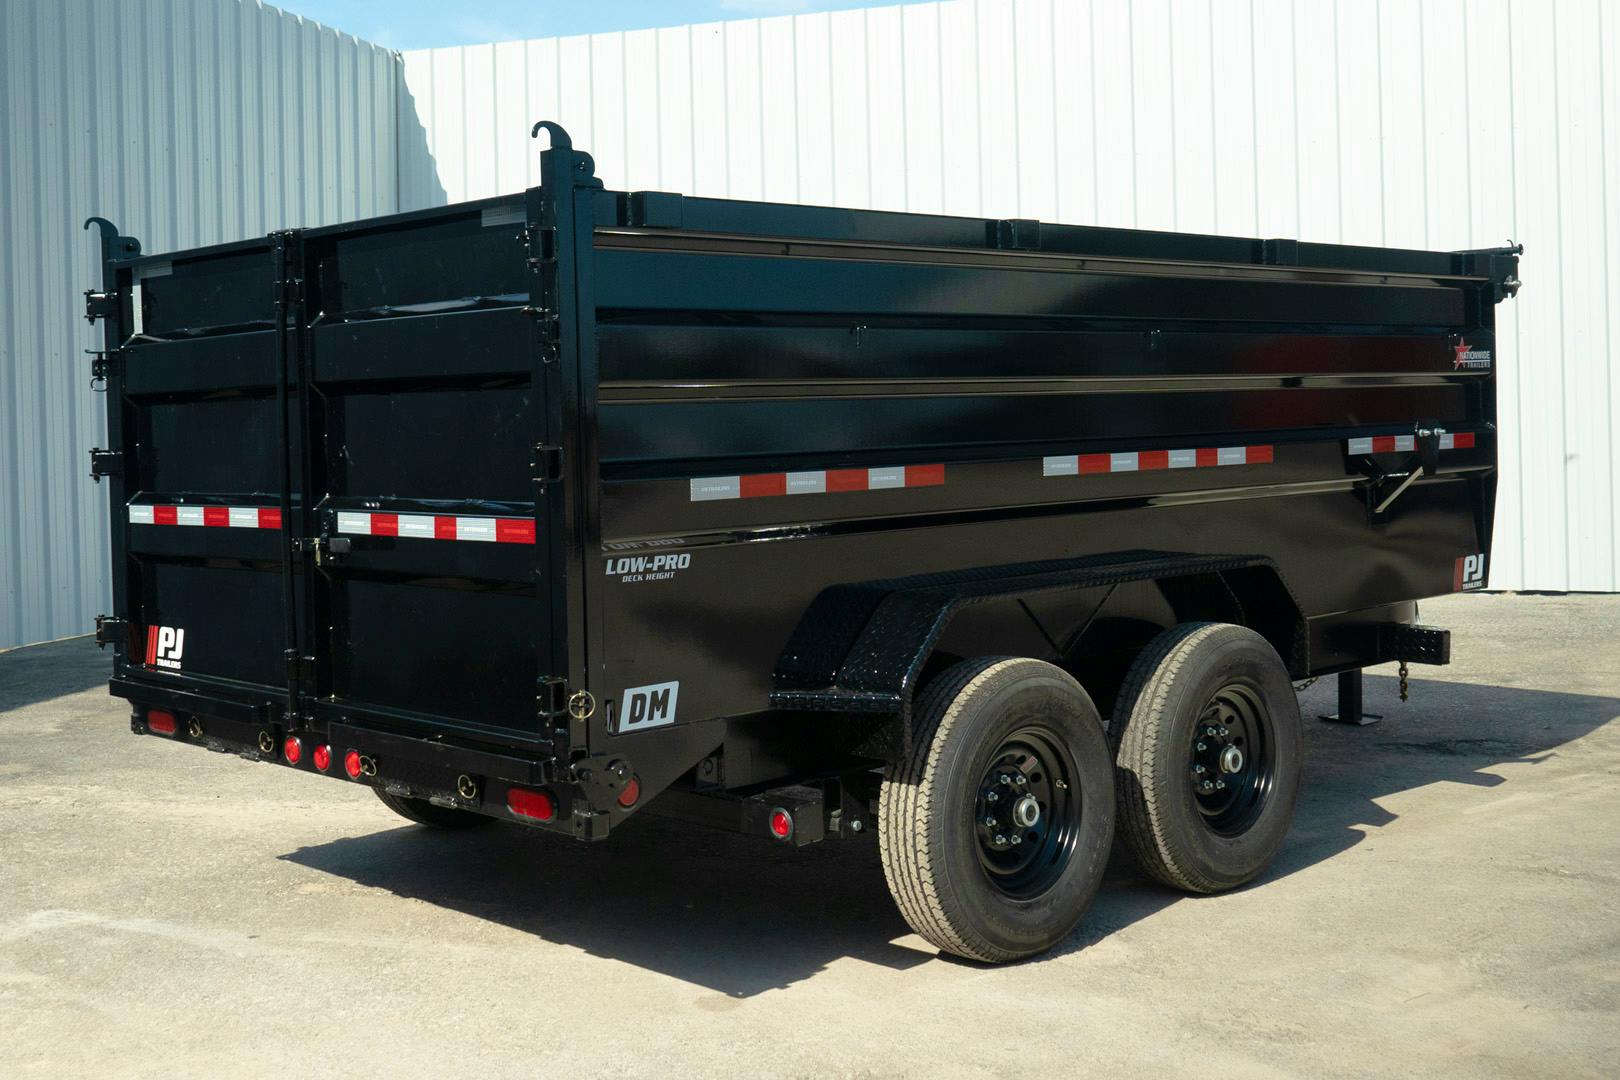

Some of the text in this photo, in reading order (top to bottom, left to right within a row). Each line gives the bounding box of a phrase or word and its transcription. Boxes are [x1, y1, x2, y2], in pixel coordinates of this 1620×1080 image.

[1460, 351, 1491, 360] NATIONWIDE
[605, 553, 691, 575] LOW-PRO
[622, 571, 676, 583] DECK HEIGHT
[1463, 553, 1485, 583] PJ
[157, 626, 185, 660] PJ
[628, 688, 671, 724] DM
